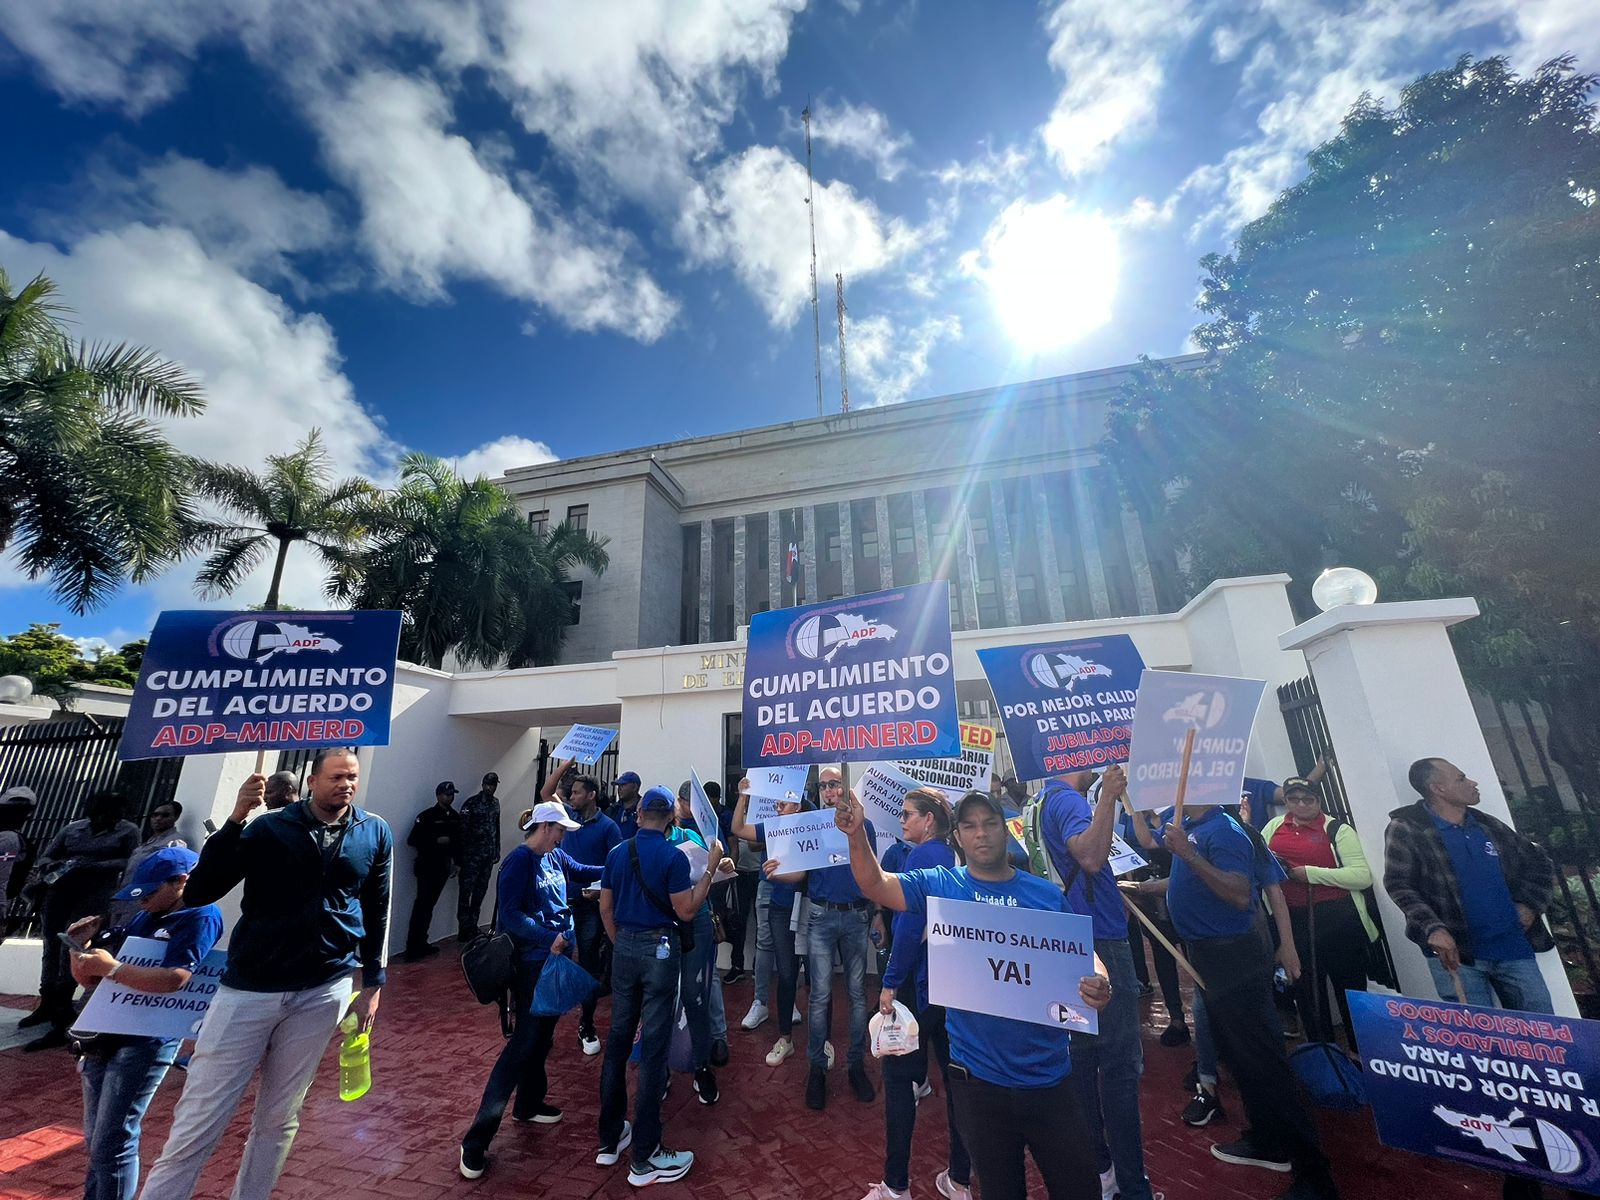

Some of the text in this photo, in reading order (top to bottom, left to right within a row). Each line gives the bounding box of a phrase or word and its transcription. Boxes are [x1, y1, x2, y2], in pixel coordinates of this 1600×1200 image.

[292, 639, 321, 647] ADP
[851, 627, 877, 639] ADP
[146, 667, 388, 690] CUMPLIMIENTO
[682, 674, 708, 689] DE
[749, 652, 950, 698] CUMPLIMIENTO
[1079, 665, 1097, 674] ADP
[153, 692, 373, 718] DEL ACUERDO
[757, 686, 941, 726] DEL ACUERDO
[1003, 702, 1038, 719] POR
[1042, 694, 1094, 714] MEJOR
[151, 719, 365, 748] ADP-MINERD
[1036, 718, 1059, 733] DE
[1060, 711, 1101, 729] VIDA
[760, 720, 938, 757] ADP-MINERD
[957, 750, 990, 765] ARIAL
[1043, 743, 1131, 772] PENSIONA
[768, 773, 784, 785] YA!
[867, 767, 907, 795] AUMENTO
[980, 767, 987, 778] Y
[863, 790, 869, 798] Y
[867, 780, 904, 807] PARA JUB
[767, 826, 805, 838] AUMENTO
[797, 839, 819, 852] YA!
[1007, 896, 1018, 906] de
[932, 923, 1088, 956] AUMENTO SALARIAL
[987, 958, 1031, 986] YA!
[111, 992, 121, 1003] Y
[1386, 999, 1574, 1043] PENSIONADOS
[1403, 1022, 1566, 1064] JUBILADOS Y
[1401, 1043, 1584, 1090] DE VIDA PARA
[1369, 1059, 1600, 1117] R MEJOR CALIDAD
[1460, 1118, 1492, 1132] ADP
